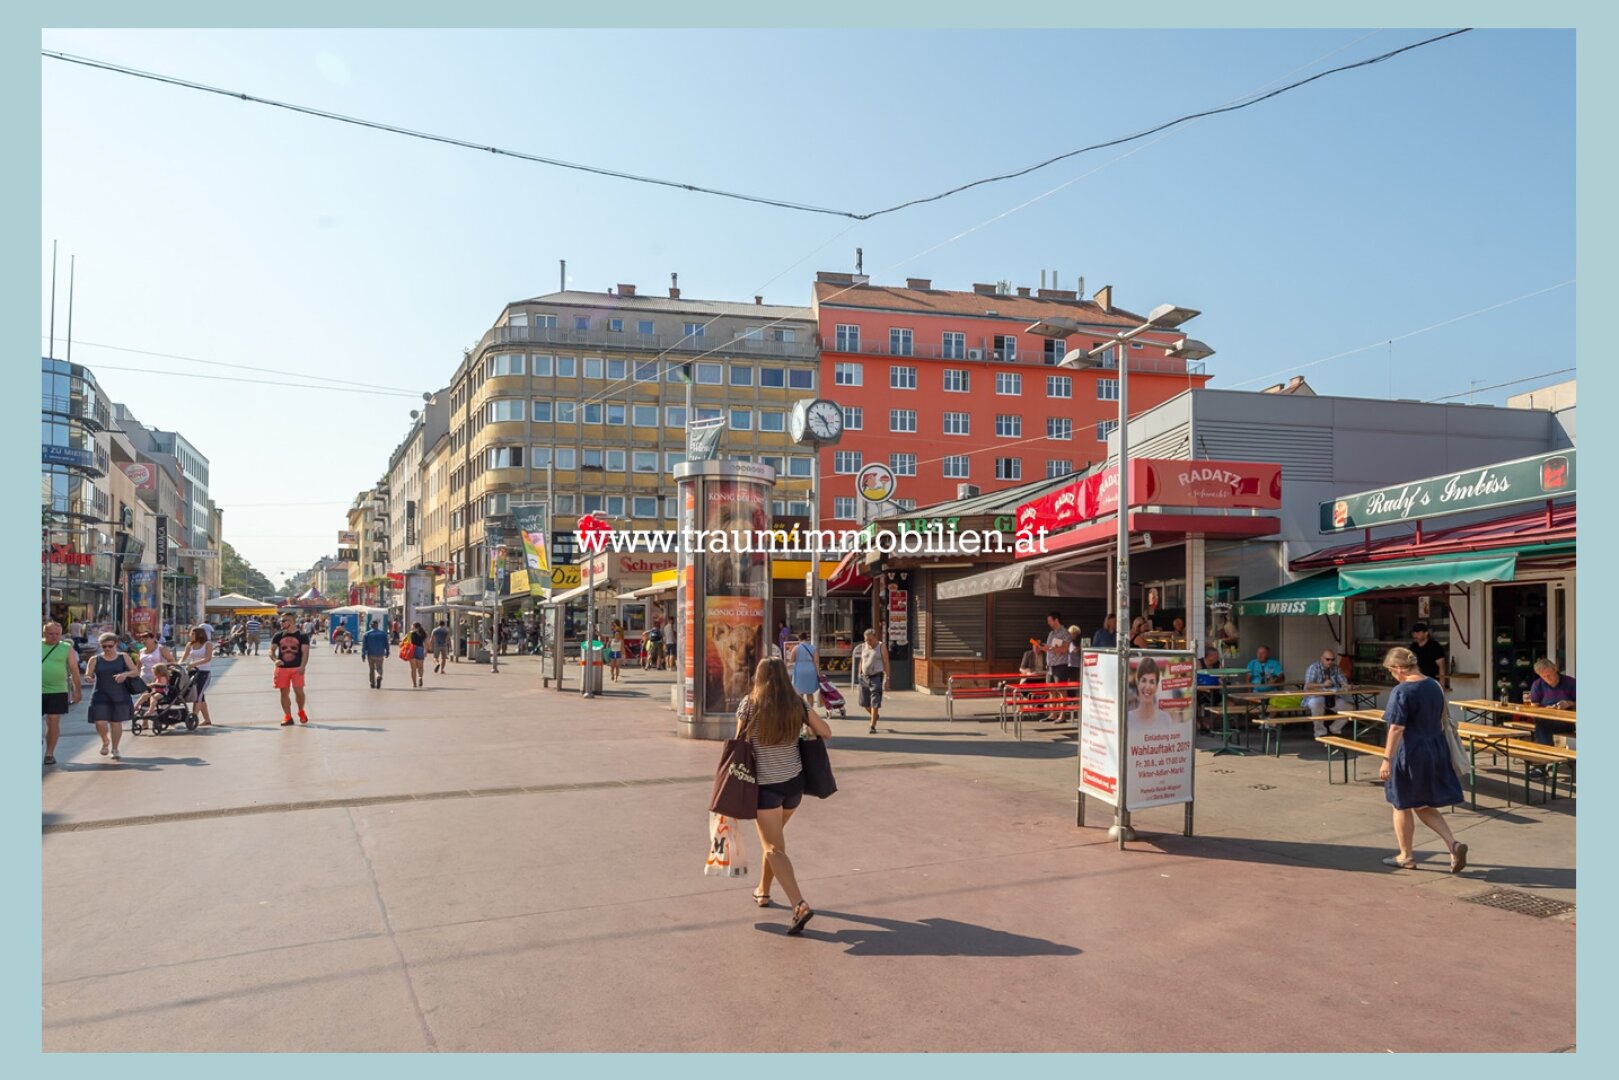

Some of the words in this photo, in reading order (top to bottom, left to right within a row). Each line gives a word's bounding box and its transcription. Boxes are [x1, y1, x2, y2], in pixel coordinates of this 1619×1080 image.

[1177, 468, 1242, 488] RADATZ
[1439, 469, 1512, 503] Imbiss
[708, 607, 735, 616] KÖNIG
[1265, 600, 1307, 615] IMBISS
[1144, 734, 1169, 742] Einladung
[1130, 743, 1176, 756] Wahlauftakt
[1176, 741, 1190, 753] 2019
[1138, 767, 1185, 778] Viktor-Adler-Markt
